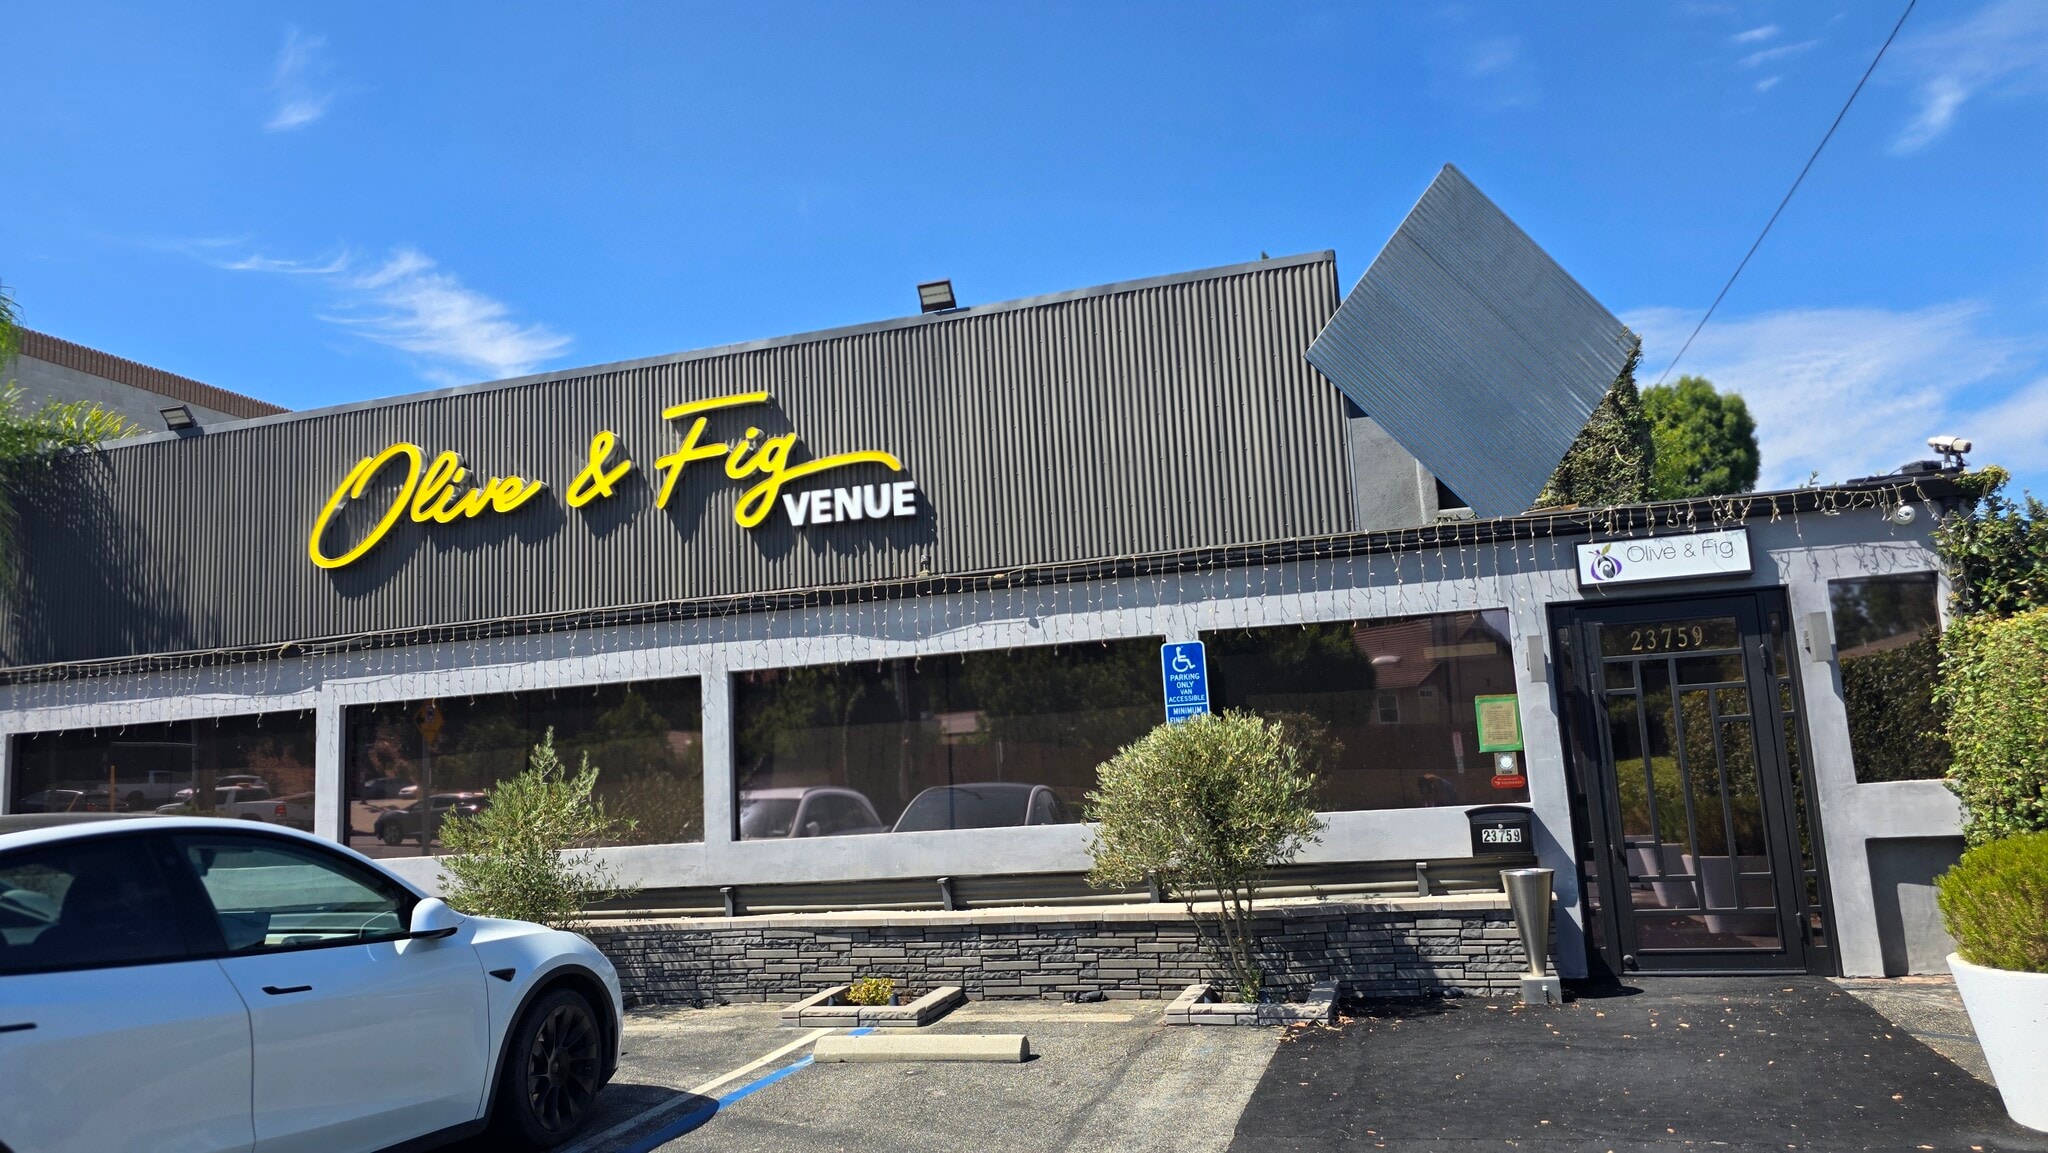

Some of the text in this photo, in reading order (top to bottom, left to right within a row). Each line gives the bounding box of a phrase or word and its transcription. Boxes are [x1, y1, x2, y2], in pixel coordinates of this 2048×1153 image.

[309, 391, 902, 568] Olive & Fig
[782, 481, 917, 527] VENUE
[1626, 538, 1734, 563] Olive & Fig
[1630, 625, 1703, 651] 23759
[1170, 673, 1200, 682] PARKING
[1173, 706, 1202, 715] MINIMUM
[1483, 829, 1521, 842] 23759
